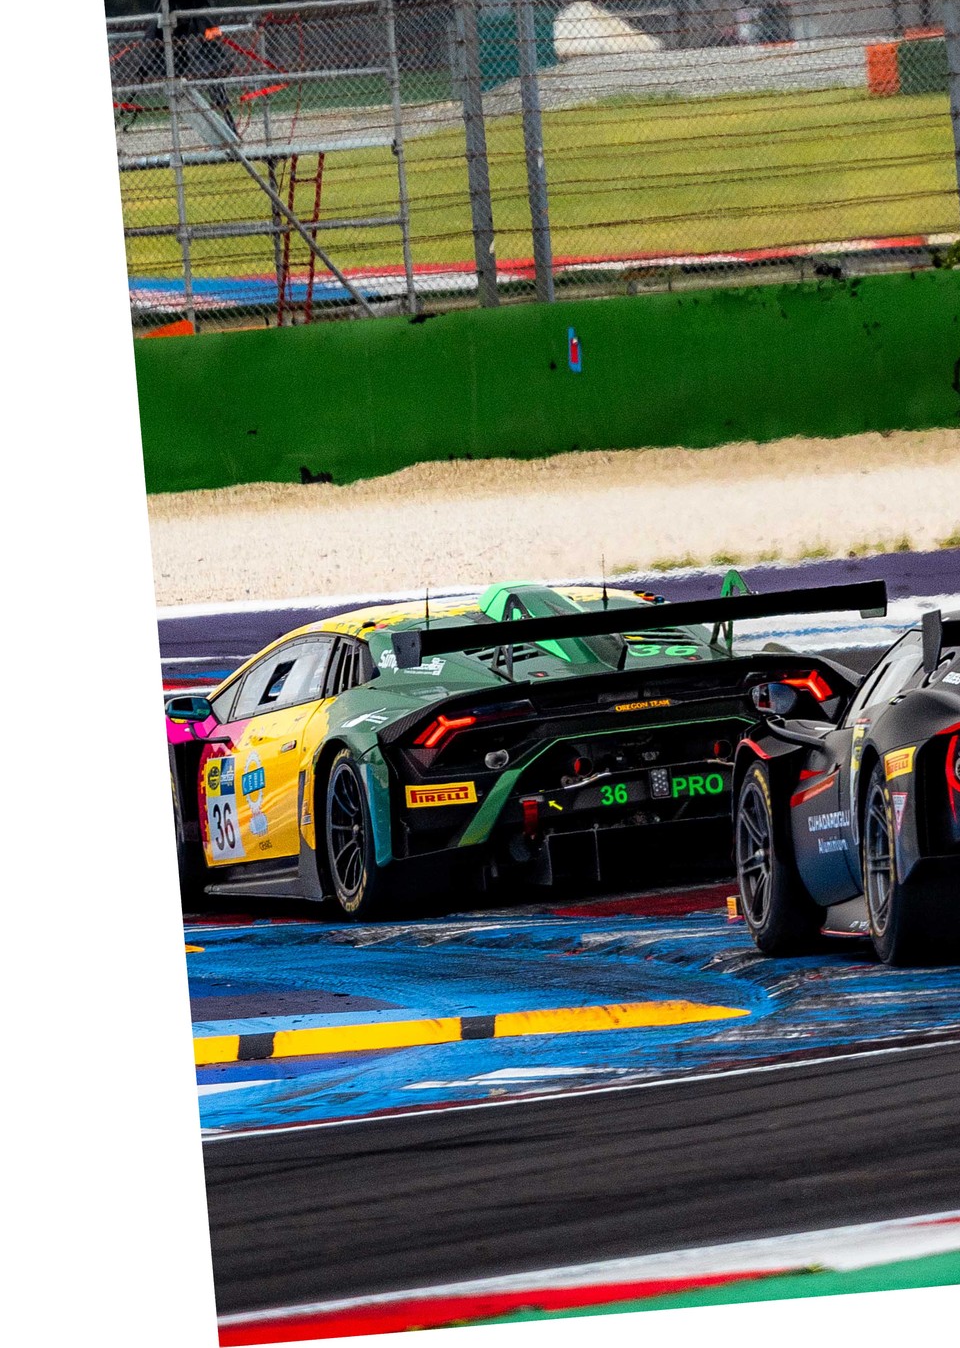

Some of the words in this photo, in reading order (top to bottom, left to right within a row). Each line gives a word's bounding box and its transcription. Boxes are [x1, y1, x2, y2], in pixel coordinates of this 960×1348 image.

[628, 644, 699, 657] 36
[615, 701, 648, 712] OREGON
[649, 698, 671, 708] TEAM
[410, 786, 469, 803] PIRELLI
[600, 783, 628, 805] 36
[671, 773, 724, 798] PRO
[213, 802, 236, 851] 36
